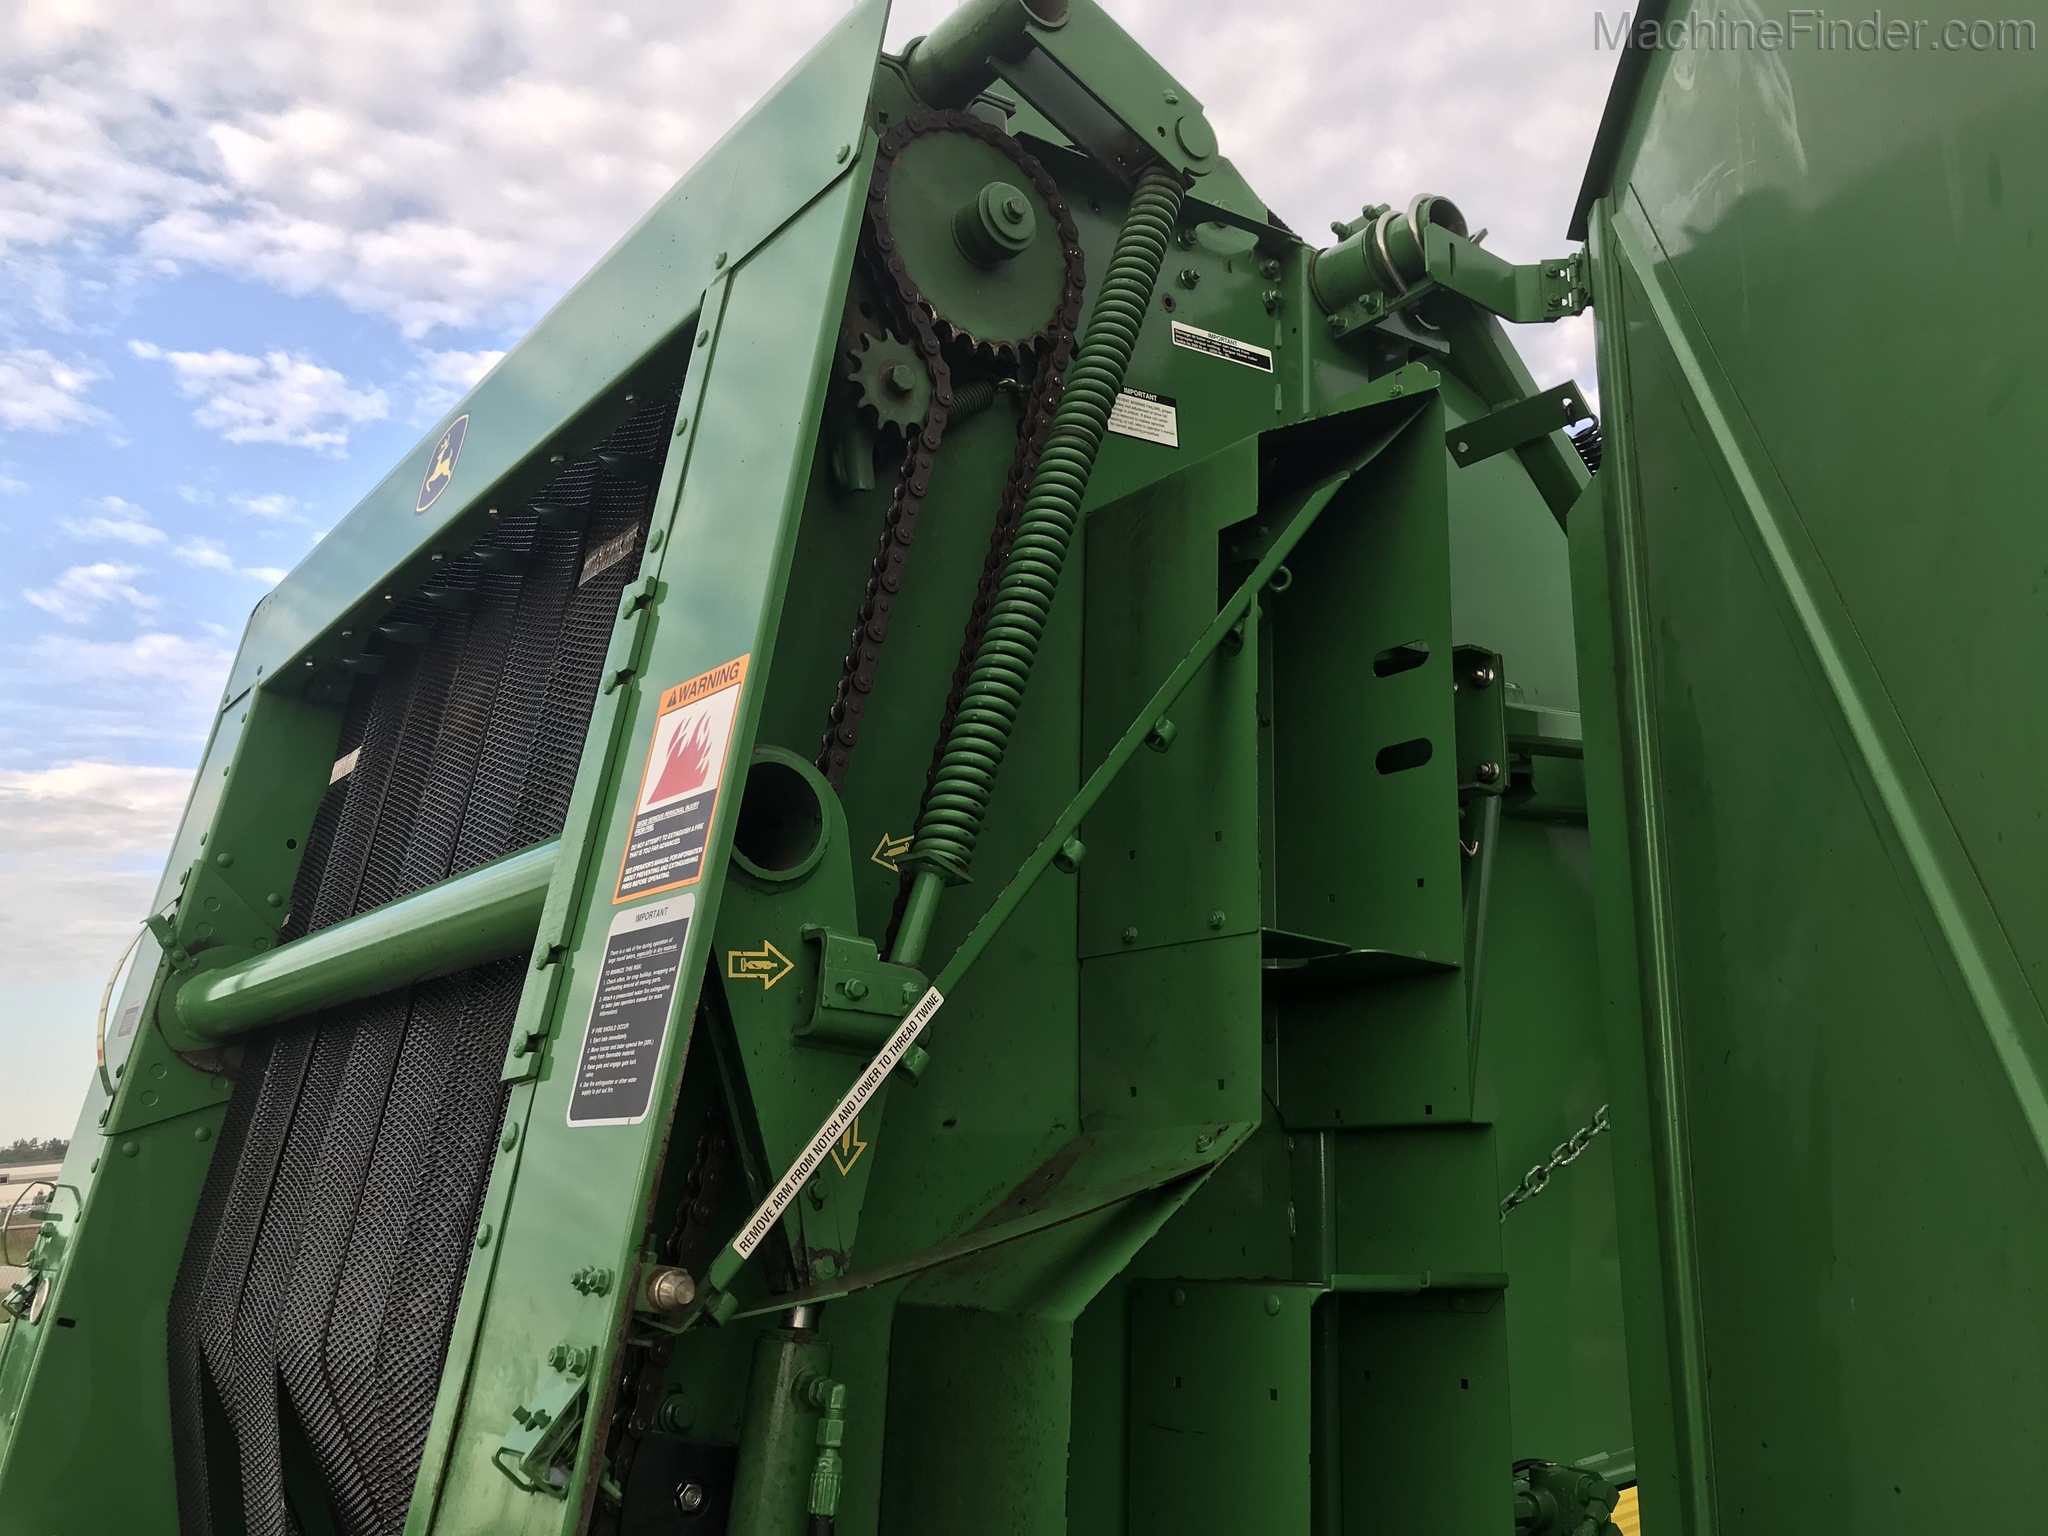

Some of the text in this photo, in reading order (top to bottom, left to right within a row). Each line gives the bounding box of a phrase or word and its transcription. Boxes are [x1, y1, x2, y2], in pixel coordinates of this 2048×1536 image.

[678, 661, 740, 703] WARNING
[645, 836, 662, 846] ATTEMPT
[694, 823, 704, 831] FIRE
[635, 906, 669, 923] IMPORTANT
[740, 993, 940, 1252] REMOVE ARM FROM NOTCH AND LOWER TO THREAD TWINE
